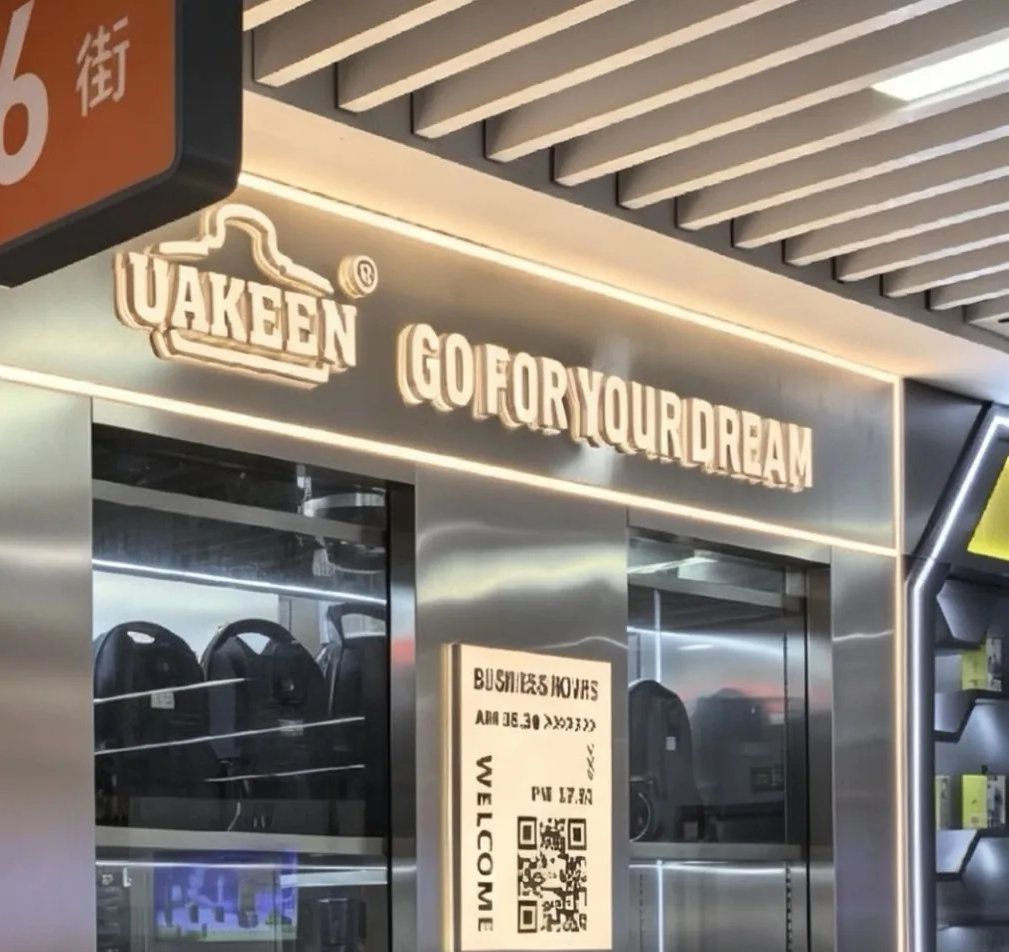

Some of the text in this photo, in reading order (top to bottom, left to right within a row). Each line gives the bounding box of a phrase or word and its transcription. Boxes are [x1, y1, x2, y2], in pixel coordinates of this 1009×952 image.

[76, 16, 130, 117] 街
[397, 323, 813, 493] GO FOR YOUR DREAM
[475, 755, 494, 932] WELCOME
